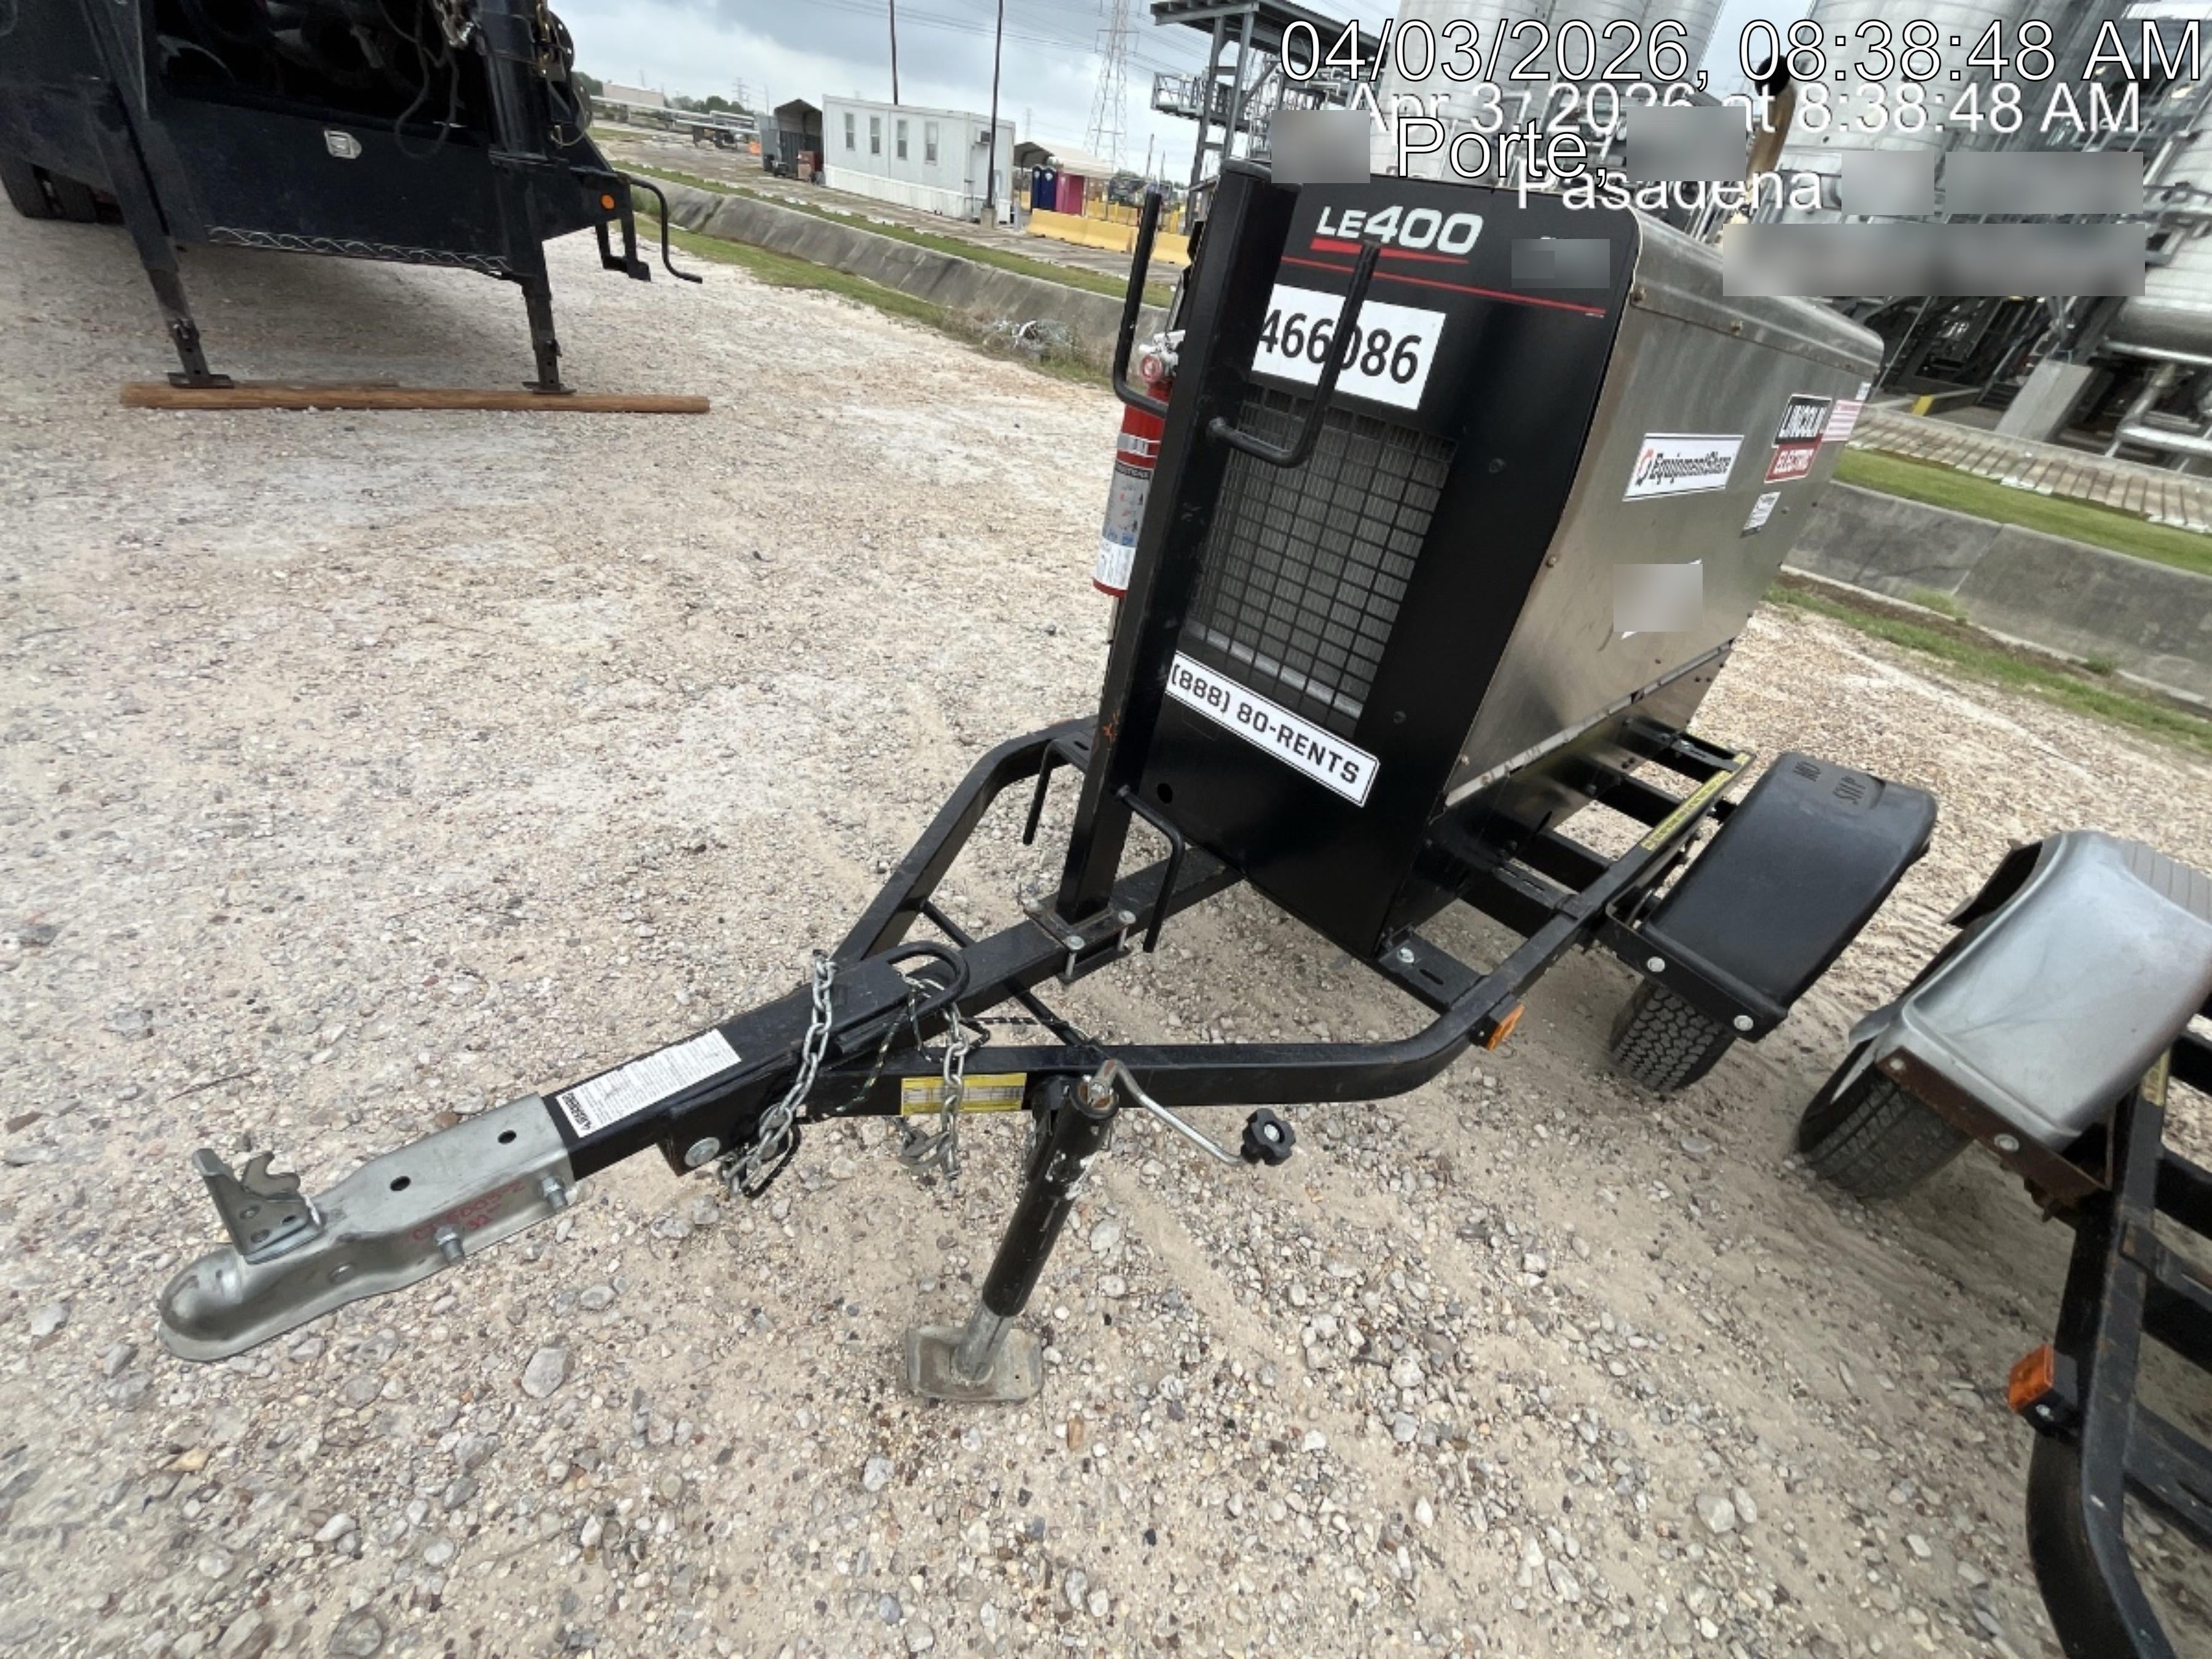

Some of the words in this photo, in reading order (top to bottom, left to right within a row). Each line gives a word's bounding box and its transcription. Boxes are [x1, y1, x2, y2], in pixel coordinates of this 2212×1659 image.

[1316, 205, 1484, 255] LE400
[1171, 662, 1231, 713] (888)
[1236, 702, 1360, 785] 80-RENTS
